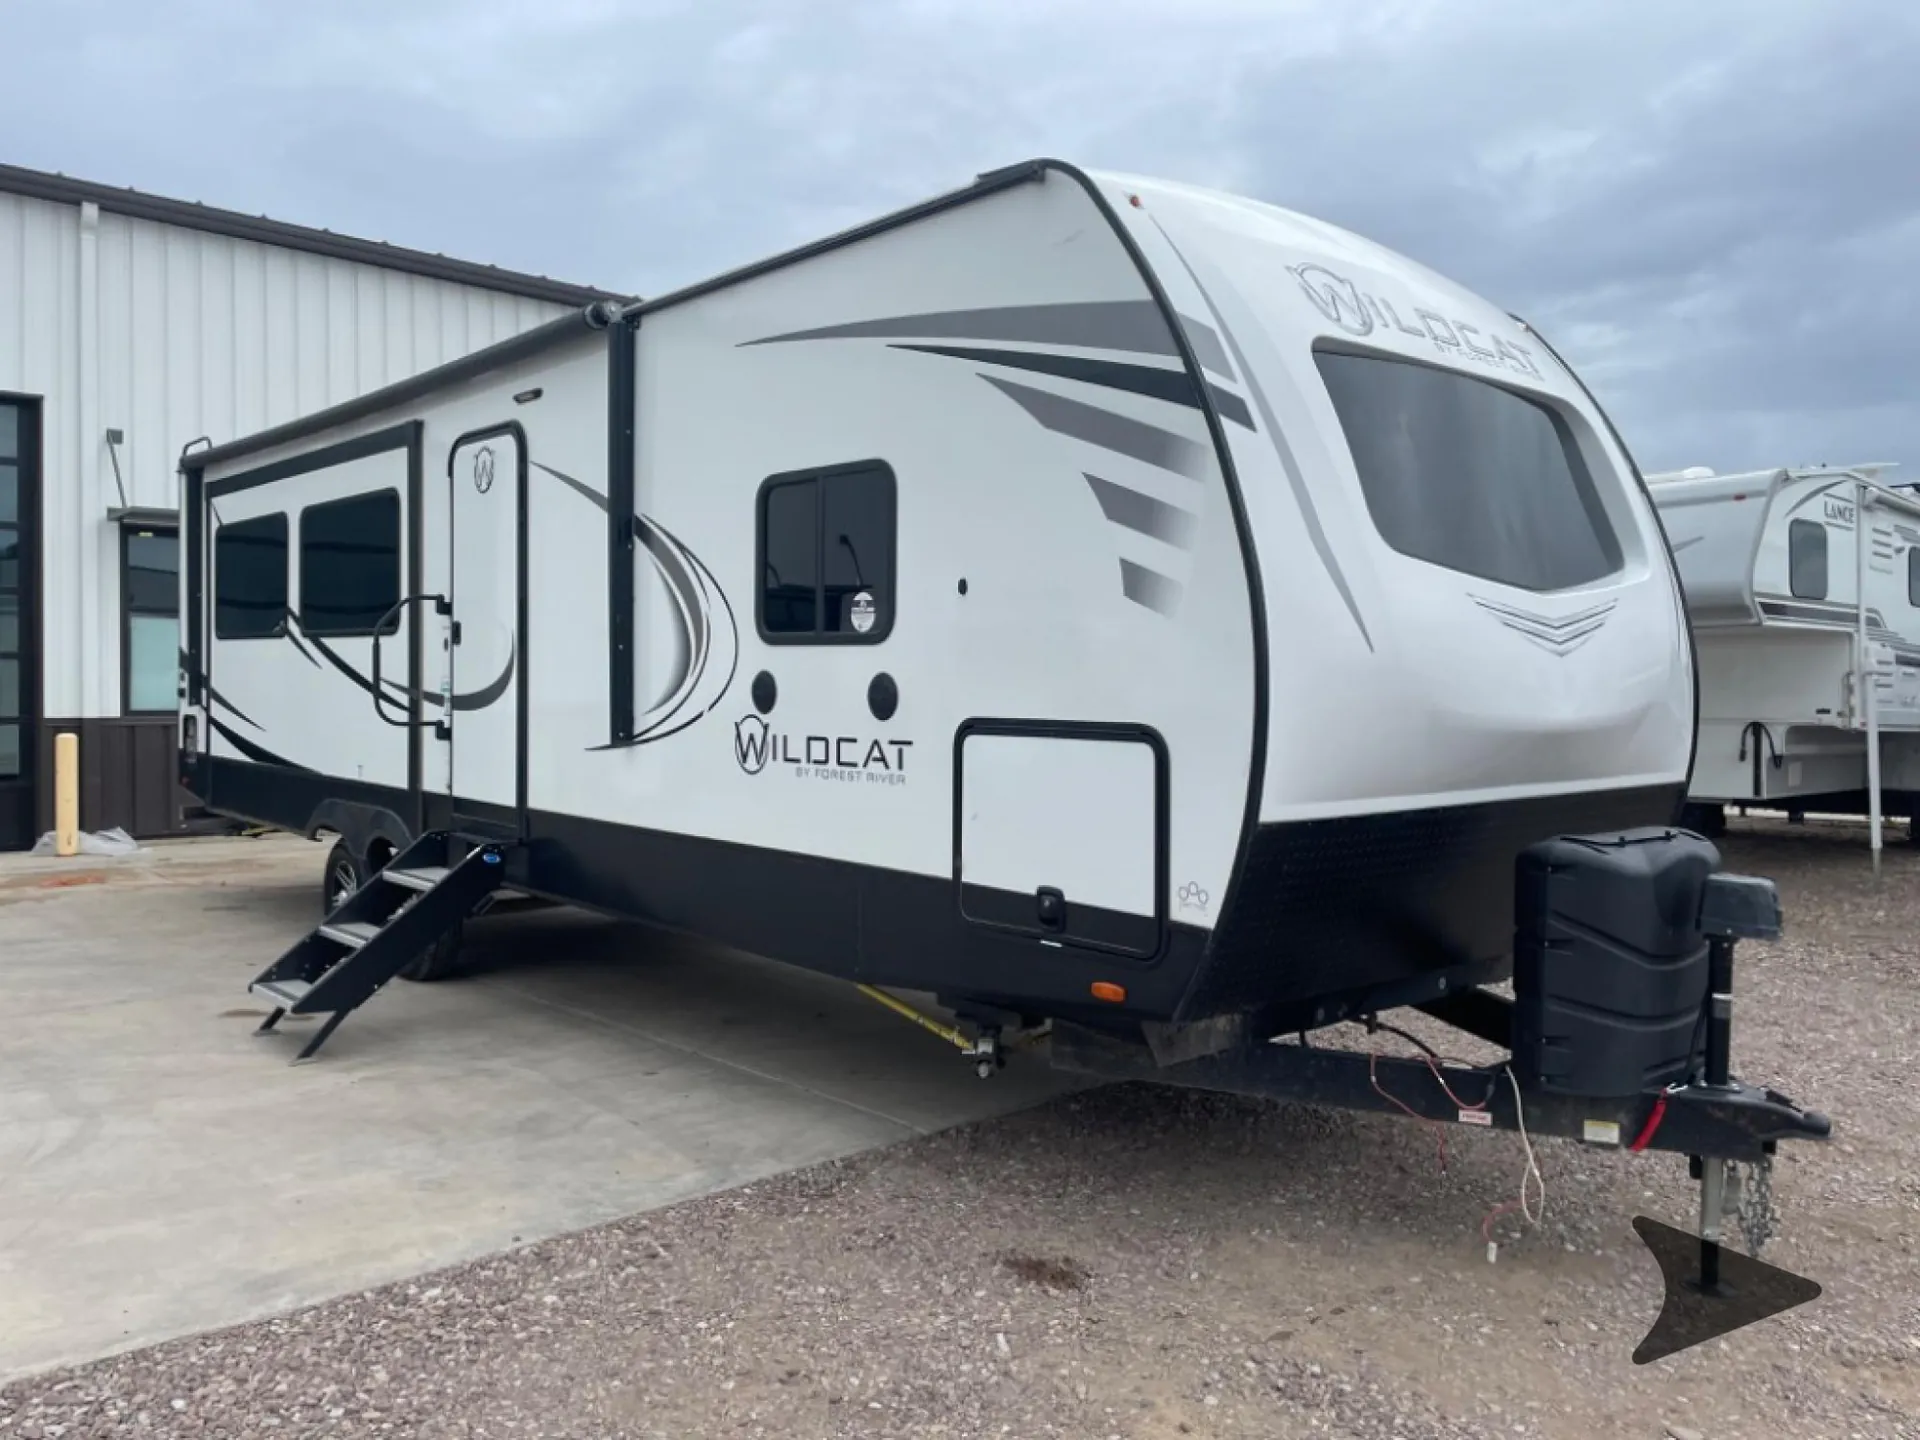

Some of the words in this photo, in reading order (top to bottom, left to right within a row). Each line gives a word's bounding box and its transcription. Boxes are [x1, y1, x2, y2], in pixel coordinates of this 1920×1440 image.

[1284, 262, 1539, 375] WILDCAT
[1824, 500, 1855, 523] LANCE
[735, 714, 913, 775] WILDCAT
[795, 766, 811, 778] BY
[815, 768, 862, 783] FOREST
[866, 771, 906, 786] RIVER
